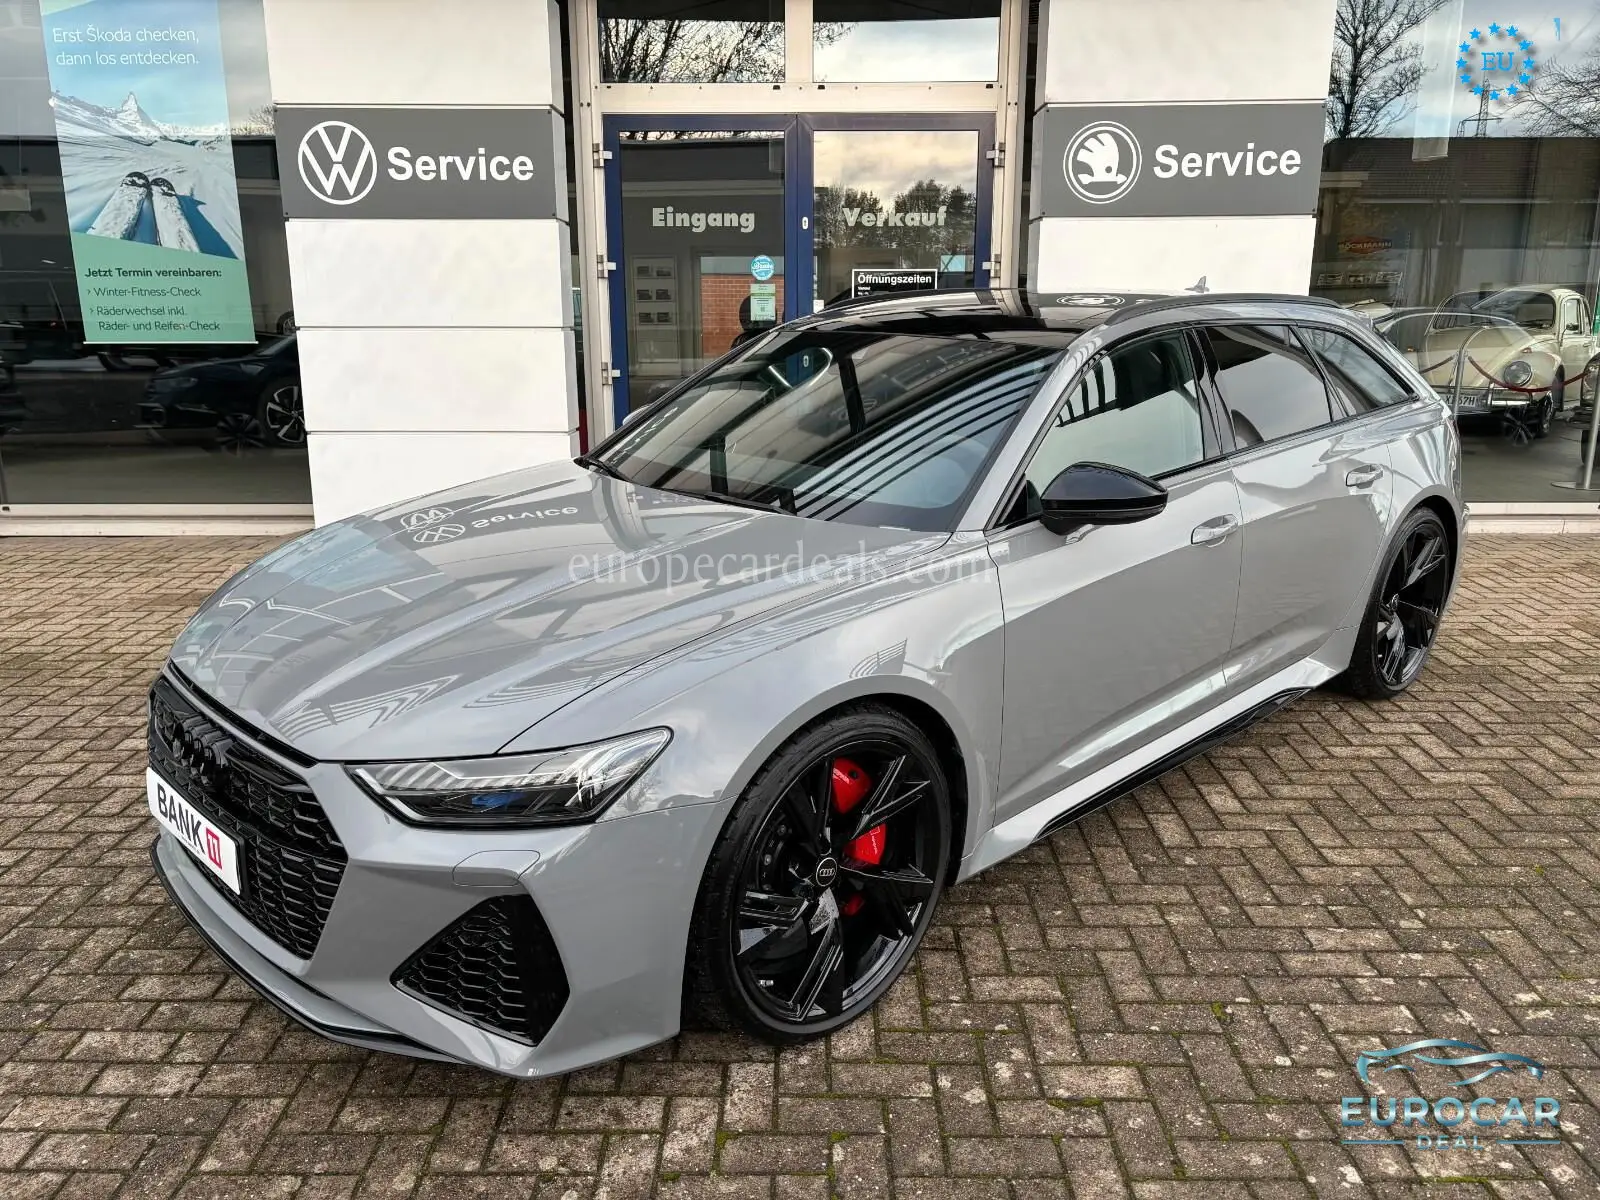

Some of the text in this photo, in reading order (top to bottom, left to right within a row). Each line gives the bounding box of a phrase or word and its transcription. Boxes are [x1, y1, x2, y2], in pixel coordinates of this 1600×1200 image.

[53, 24, 200, 44] Erst Škoda checken,
[56, 51, 200, 65] dann los entdecken.
[387, 146, 534, 181] Service
[1153, 143, 1301, 179] Service
[652, 206, 755, 233] Eingang
[842, 205, 948, 227] Verkauf
[85, 267, 222, 278] Jetzt Termin vereinbaren:
[857, 272, 932, 285] Öffnungszeiten
[94, 287, 202, 297] Winter-Fitness-Check
[96, 306, 165, 315] Räderwechsel
[99, 321, 220, 331] Räder- und Reifen-Check
[157, 782, 206, 855] BANK
